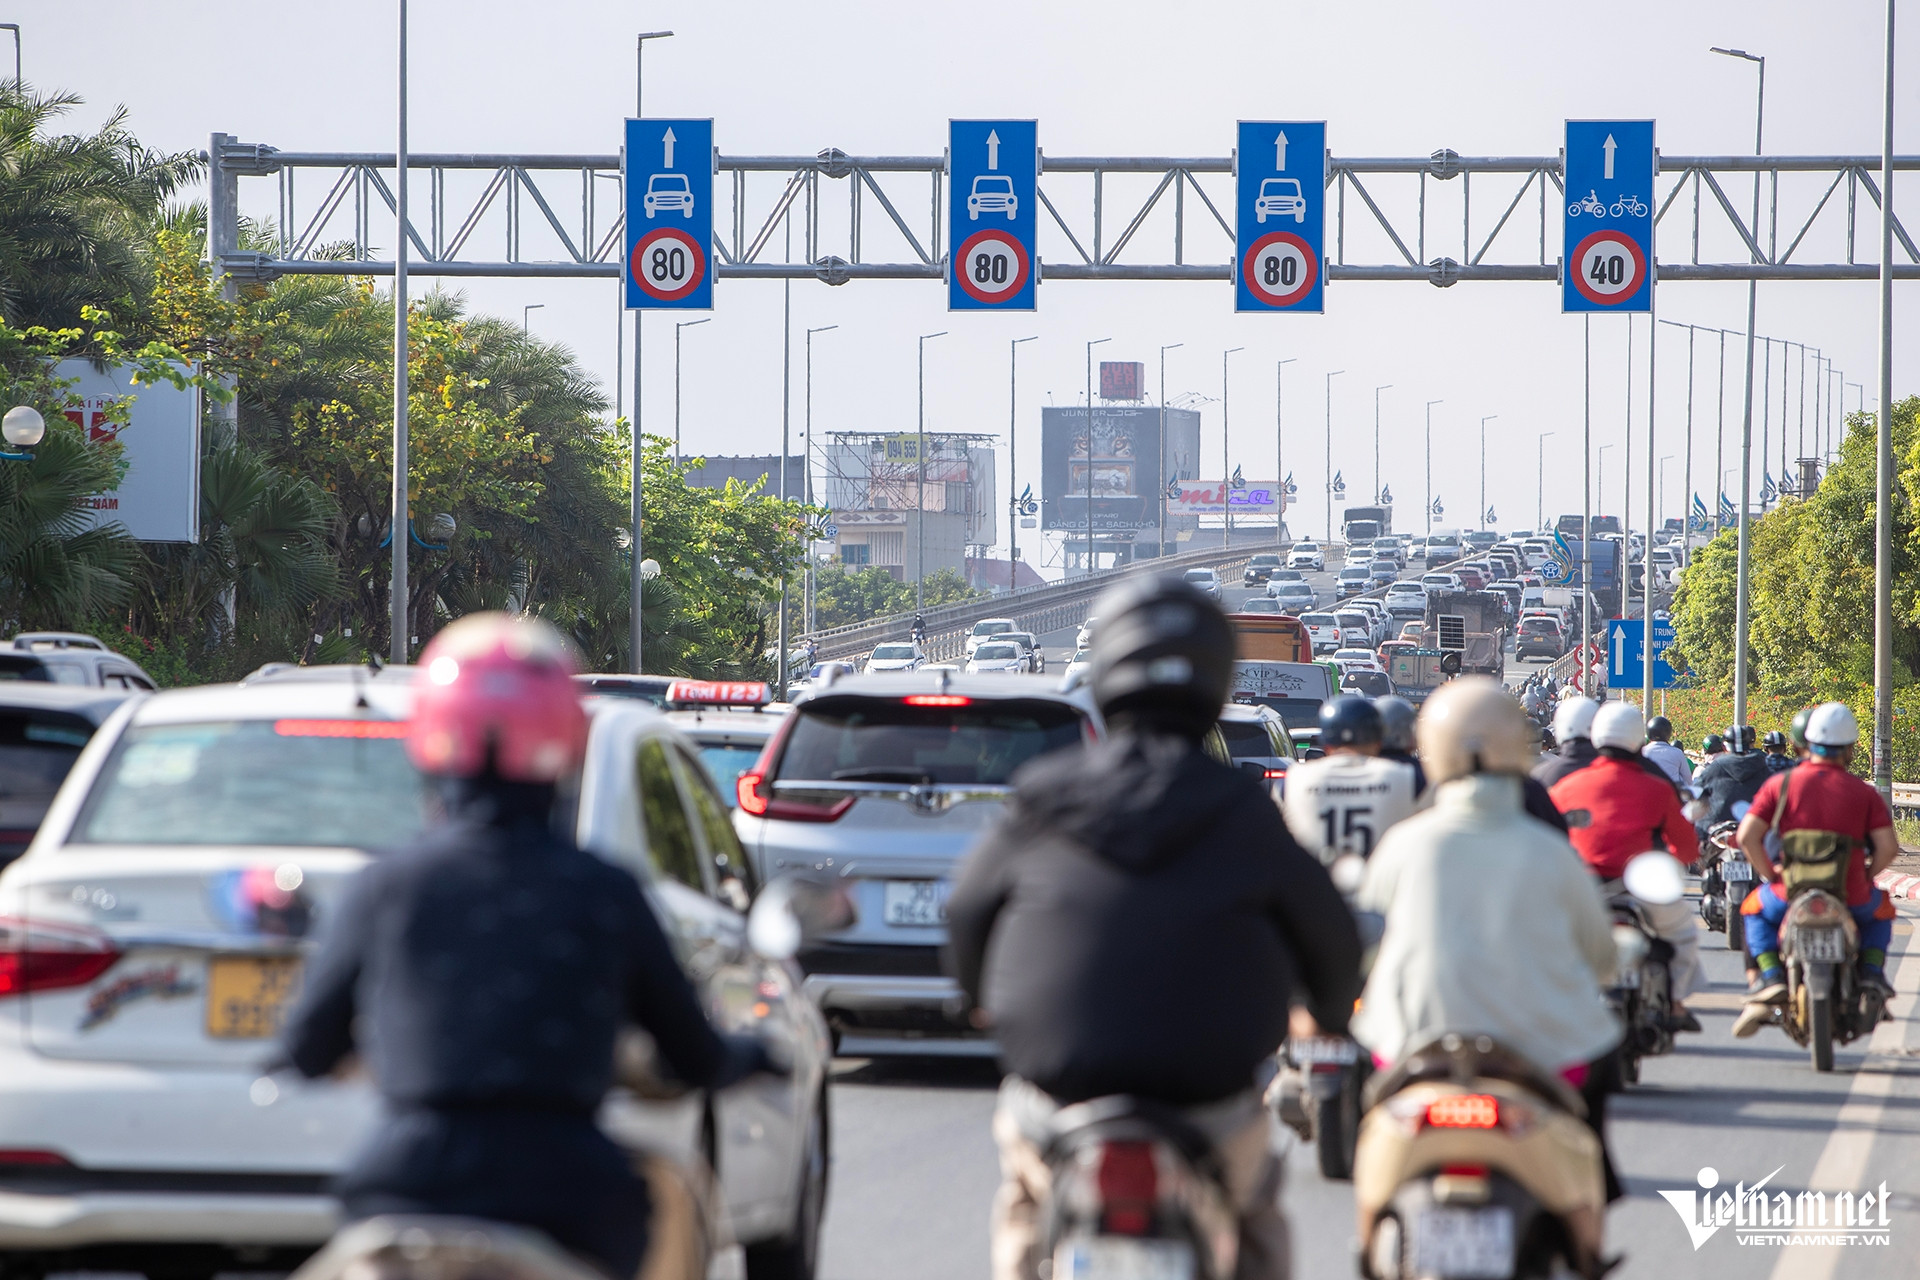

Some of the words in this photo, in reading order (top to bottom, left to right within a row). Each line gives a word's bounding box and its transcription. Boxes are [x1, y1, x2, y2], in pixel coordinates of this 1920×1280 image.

[652, 248, 685, 281] 80
[975, 253, 1008, 284] 80
[1264, 256, 1297, 286] 80
[1590, 255, 1625, 286] 40
[887, 441, 902, 459] 094
[904, 441, 917, 458] 555
[93, 499, 119, 510] NAM
[1253, 669, 1271, 677] VIP
[677, 684, 718, 699] Taxi
[721, 684, 761, 700] 123
[1318, 807, 1372, 859] 15
